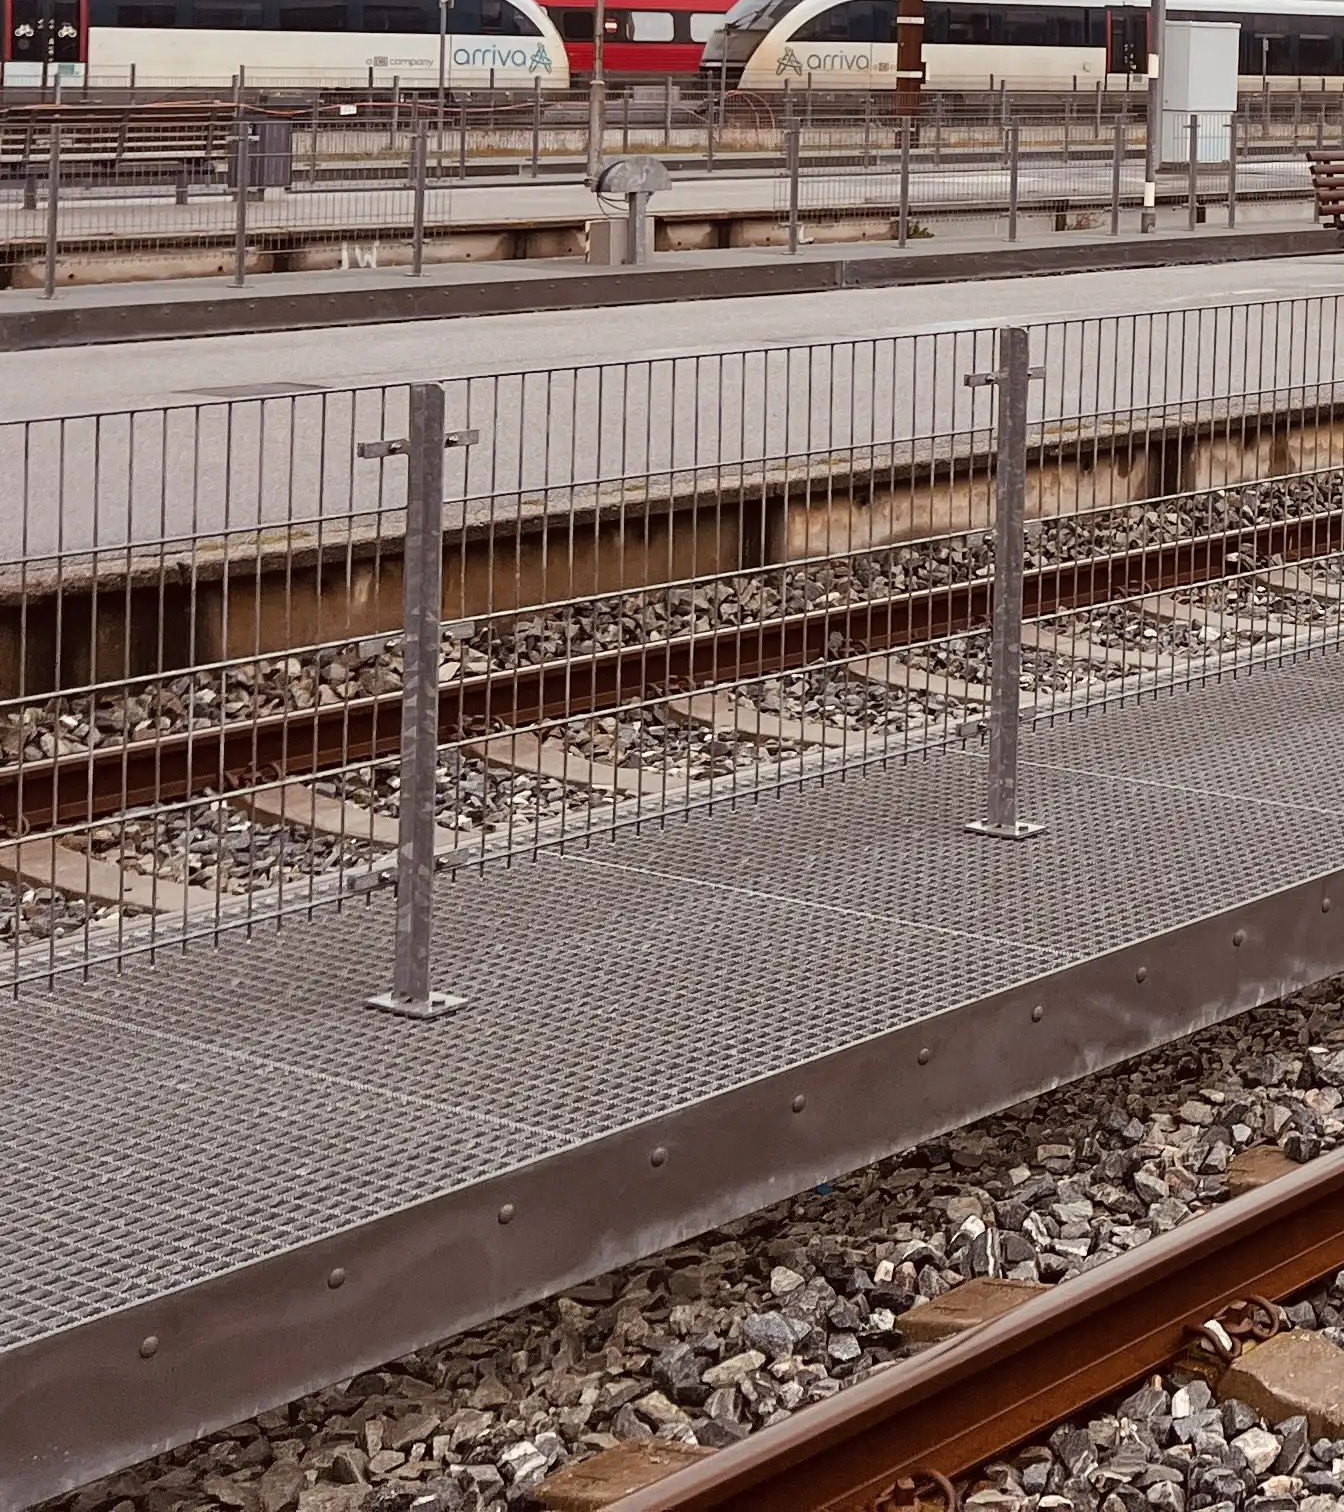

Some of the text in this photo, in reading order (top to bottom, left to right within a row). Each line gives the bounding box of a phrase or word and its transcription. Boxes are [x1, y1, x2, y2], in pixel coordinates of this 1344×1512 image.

[390, 57, 434, 67] company
[453, 44, 526, 66] arriva
[807, 49, 869, 70] arriva
